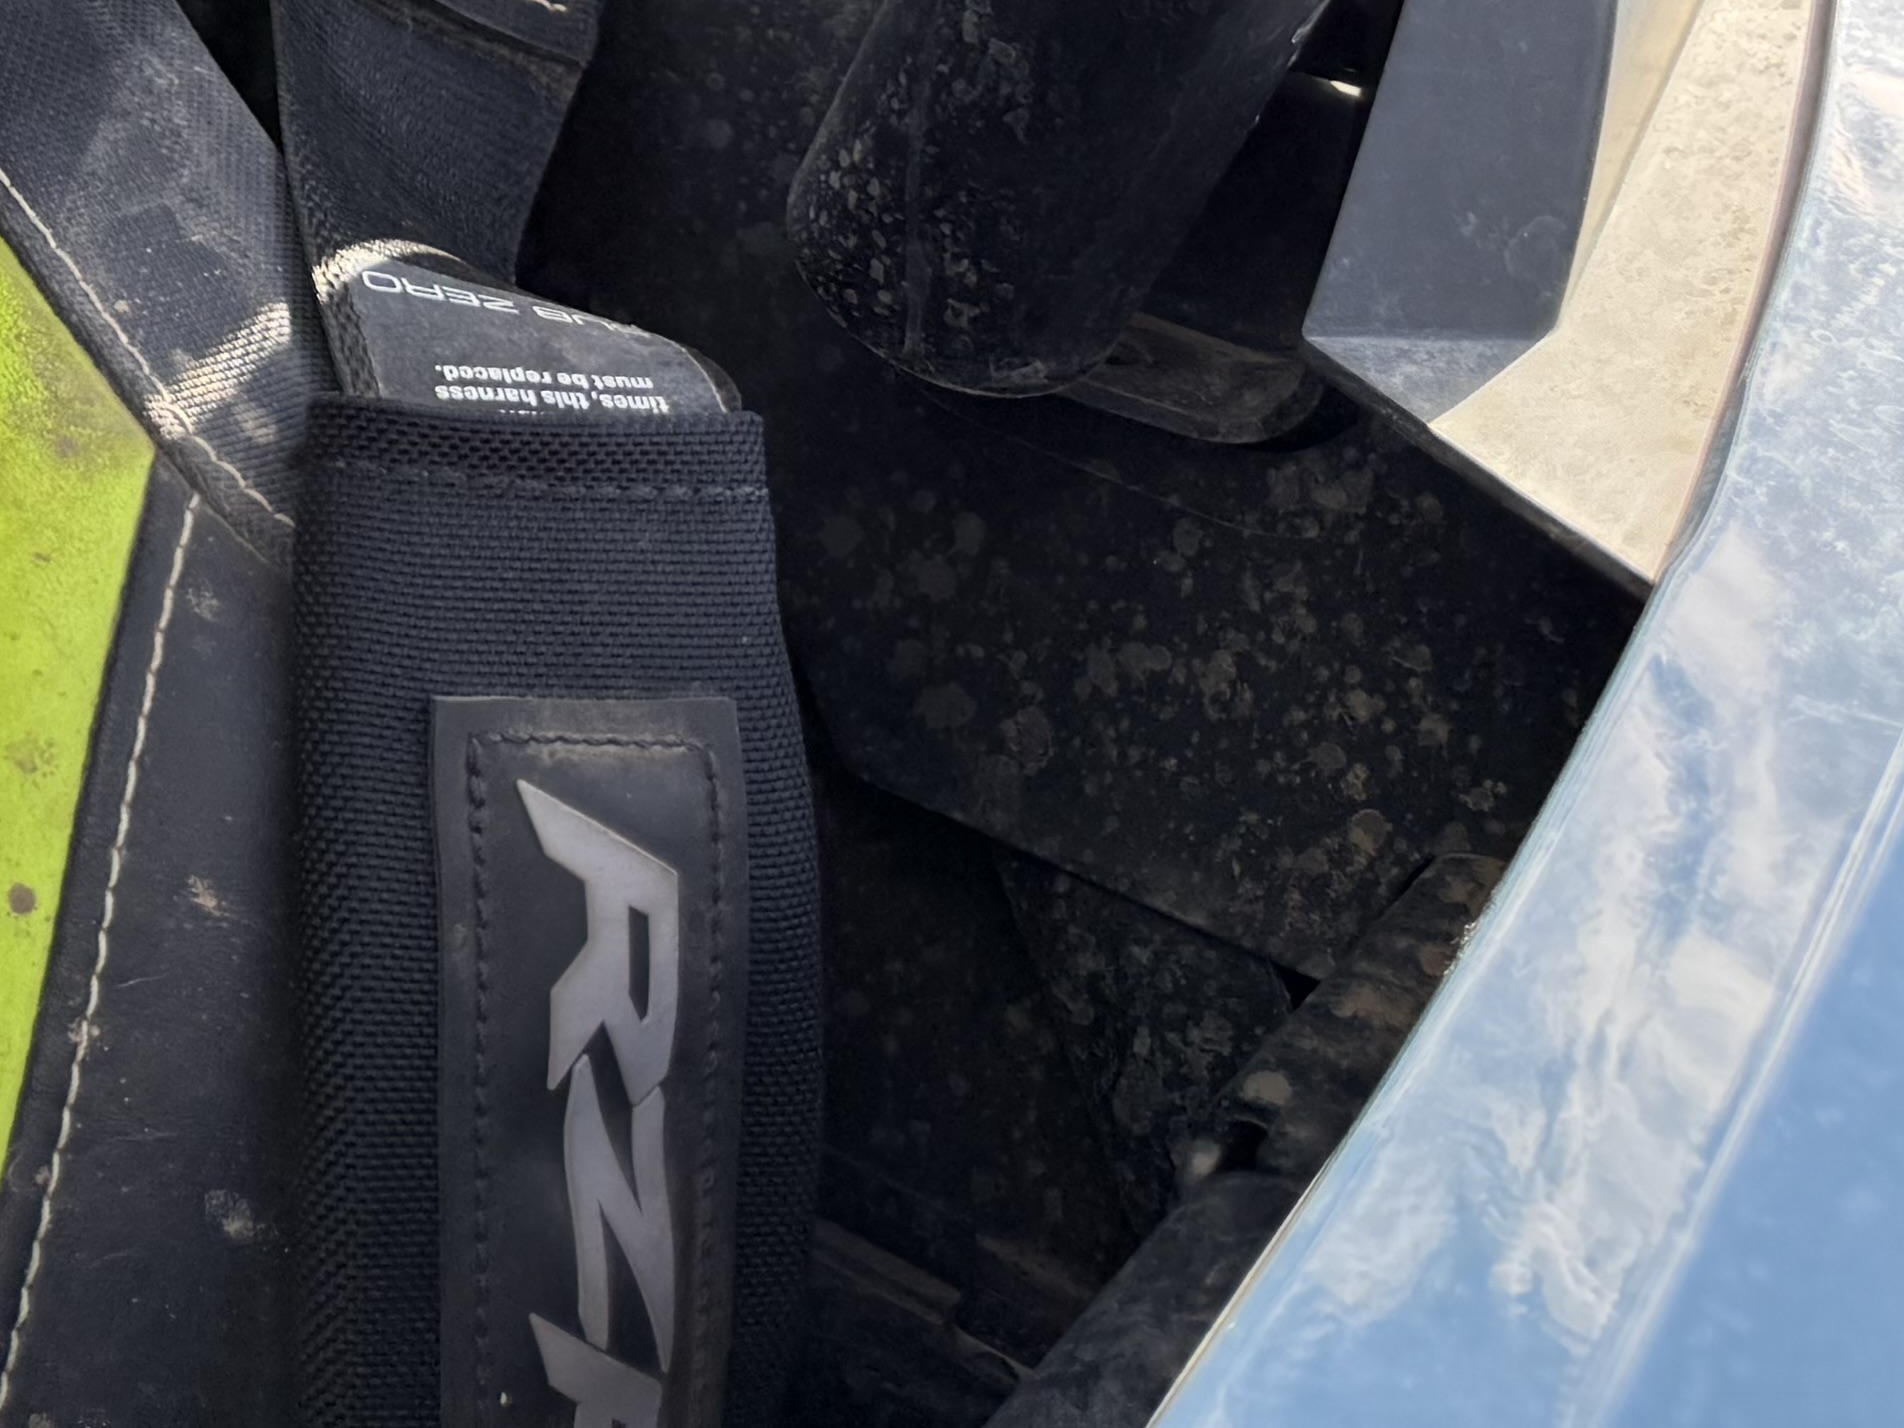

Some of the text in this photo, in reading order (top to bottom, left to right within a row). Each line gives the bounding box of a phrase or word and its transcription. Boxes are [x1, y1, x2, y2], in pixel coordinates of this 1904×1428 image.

[360, 270, 520, 315] ZERO
[434, 363, 654, 390] must be replaced.
[435, 384, 670, 415] times, this harness
